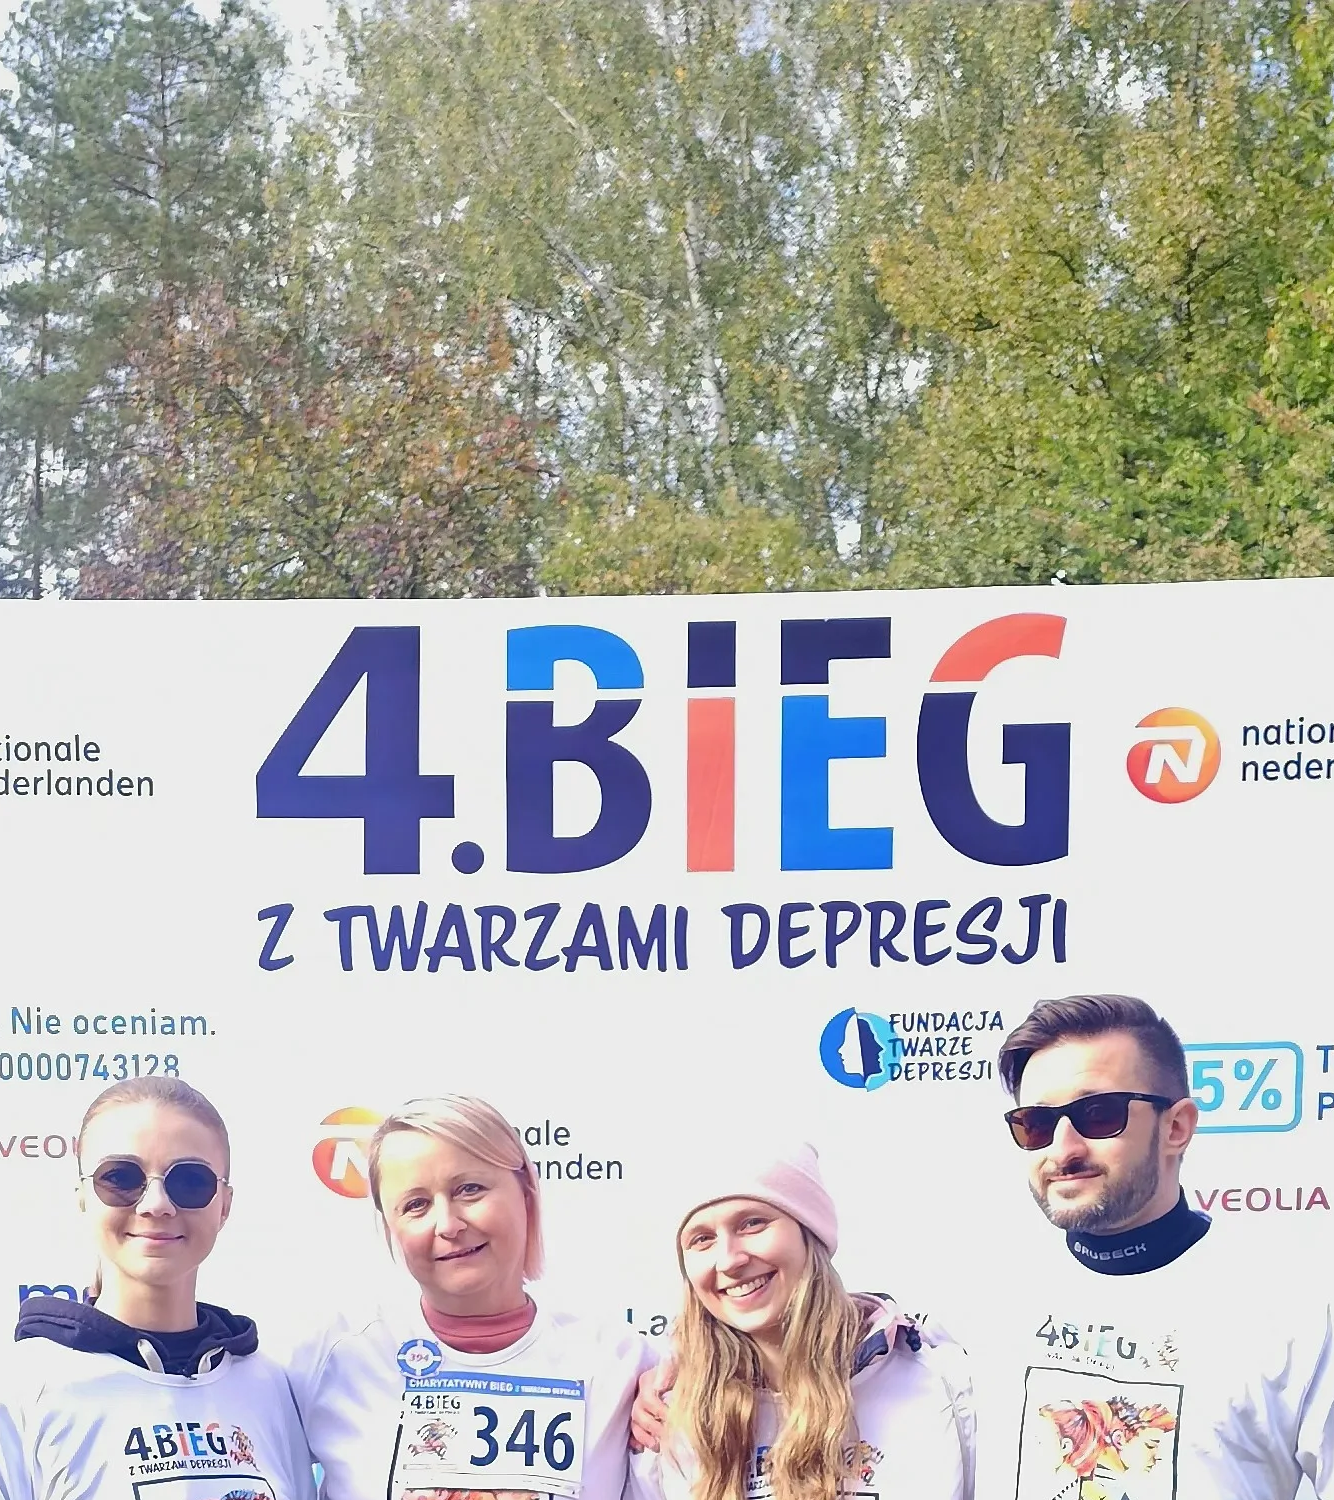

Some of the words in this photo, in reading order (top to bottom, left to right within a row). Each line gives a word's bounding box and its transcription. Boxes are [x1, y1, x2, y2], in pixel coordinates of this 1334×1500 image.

[257, 902, 295, 973] Z
[323, 900, 689, 973] TWARZAMI
[721, 893, 1069, 969] DEPRESJI
[11, 1007, 62, 1036] Nie
[73, 1008, 218, 1038] oceniam.
[888, 1010, 1005, 1034] FUNDACJA
[888, 1036, 974, 1058] TWARZE
[888, 1060, 994, 1082] DEPRESJI
[1192, 1058, 1283, 1113] 5%
[1195, 1187, 1331, 1212] VEOLIA
[123, 1422, 228, 1462] 4.BIEG
[469, 1405, 575, 1472] 346
